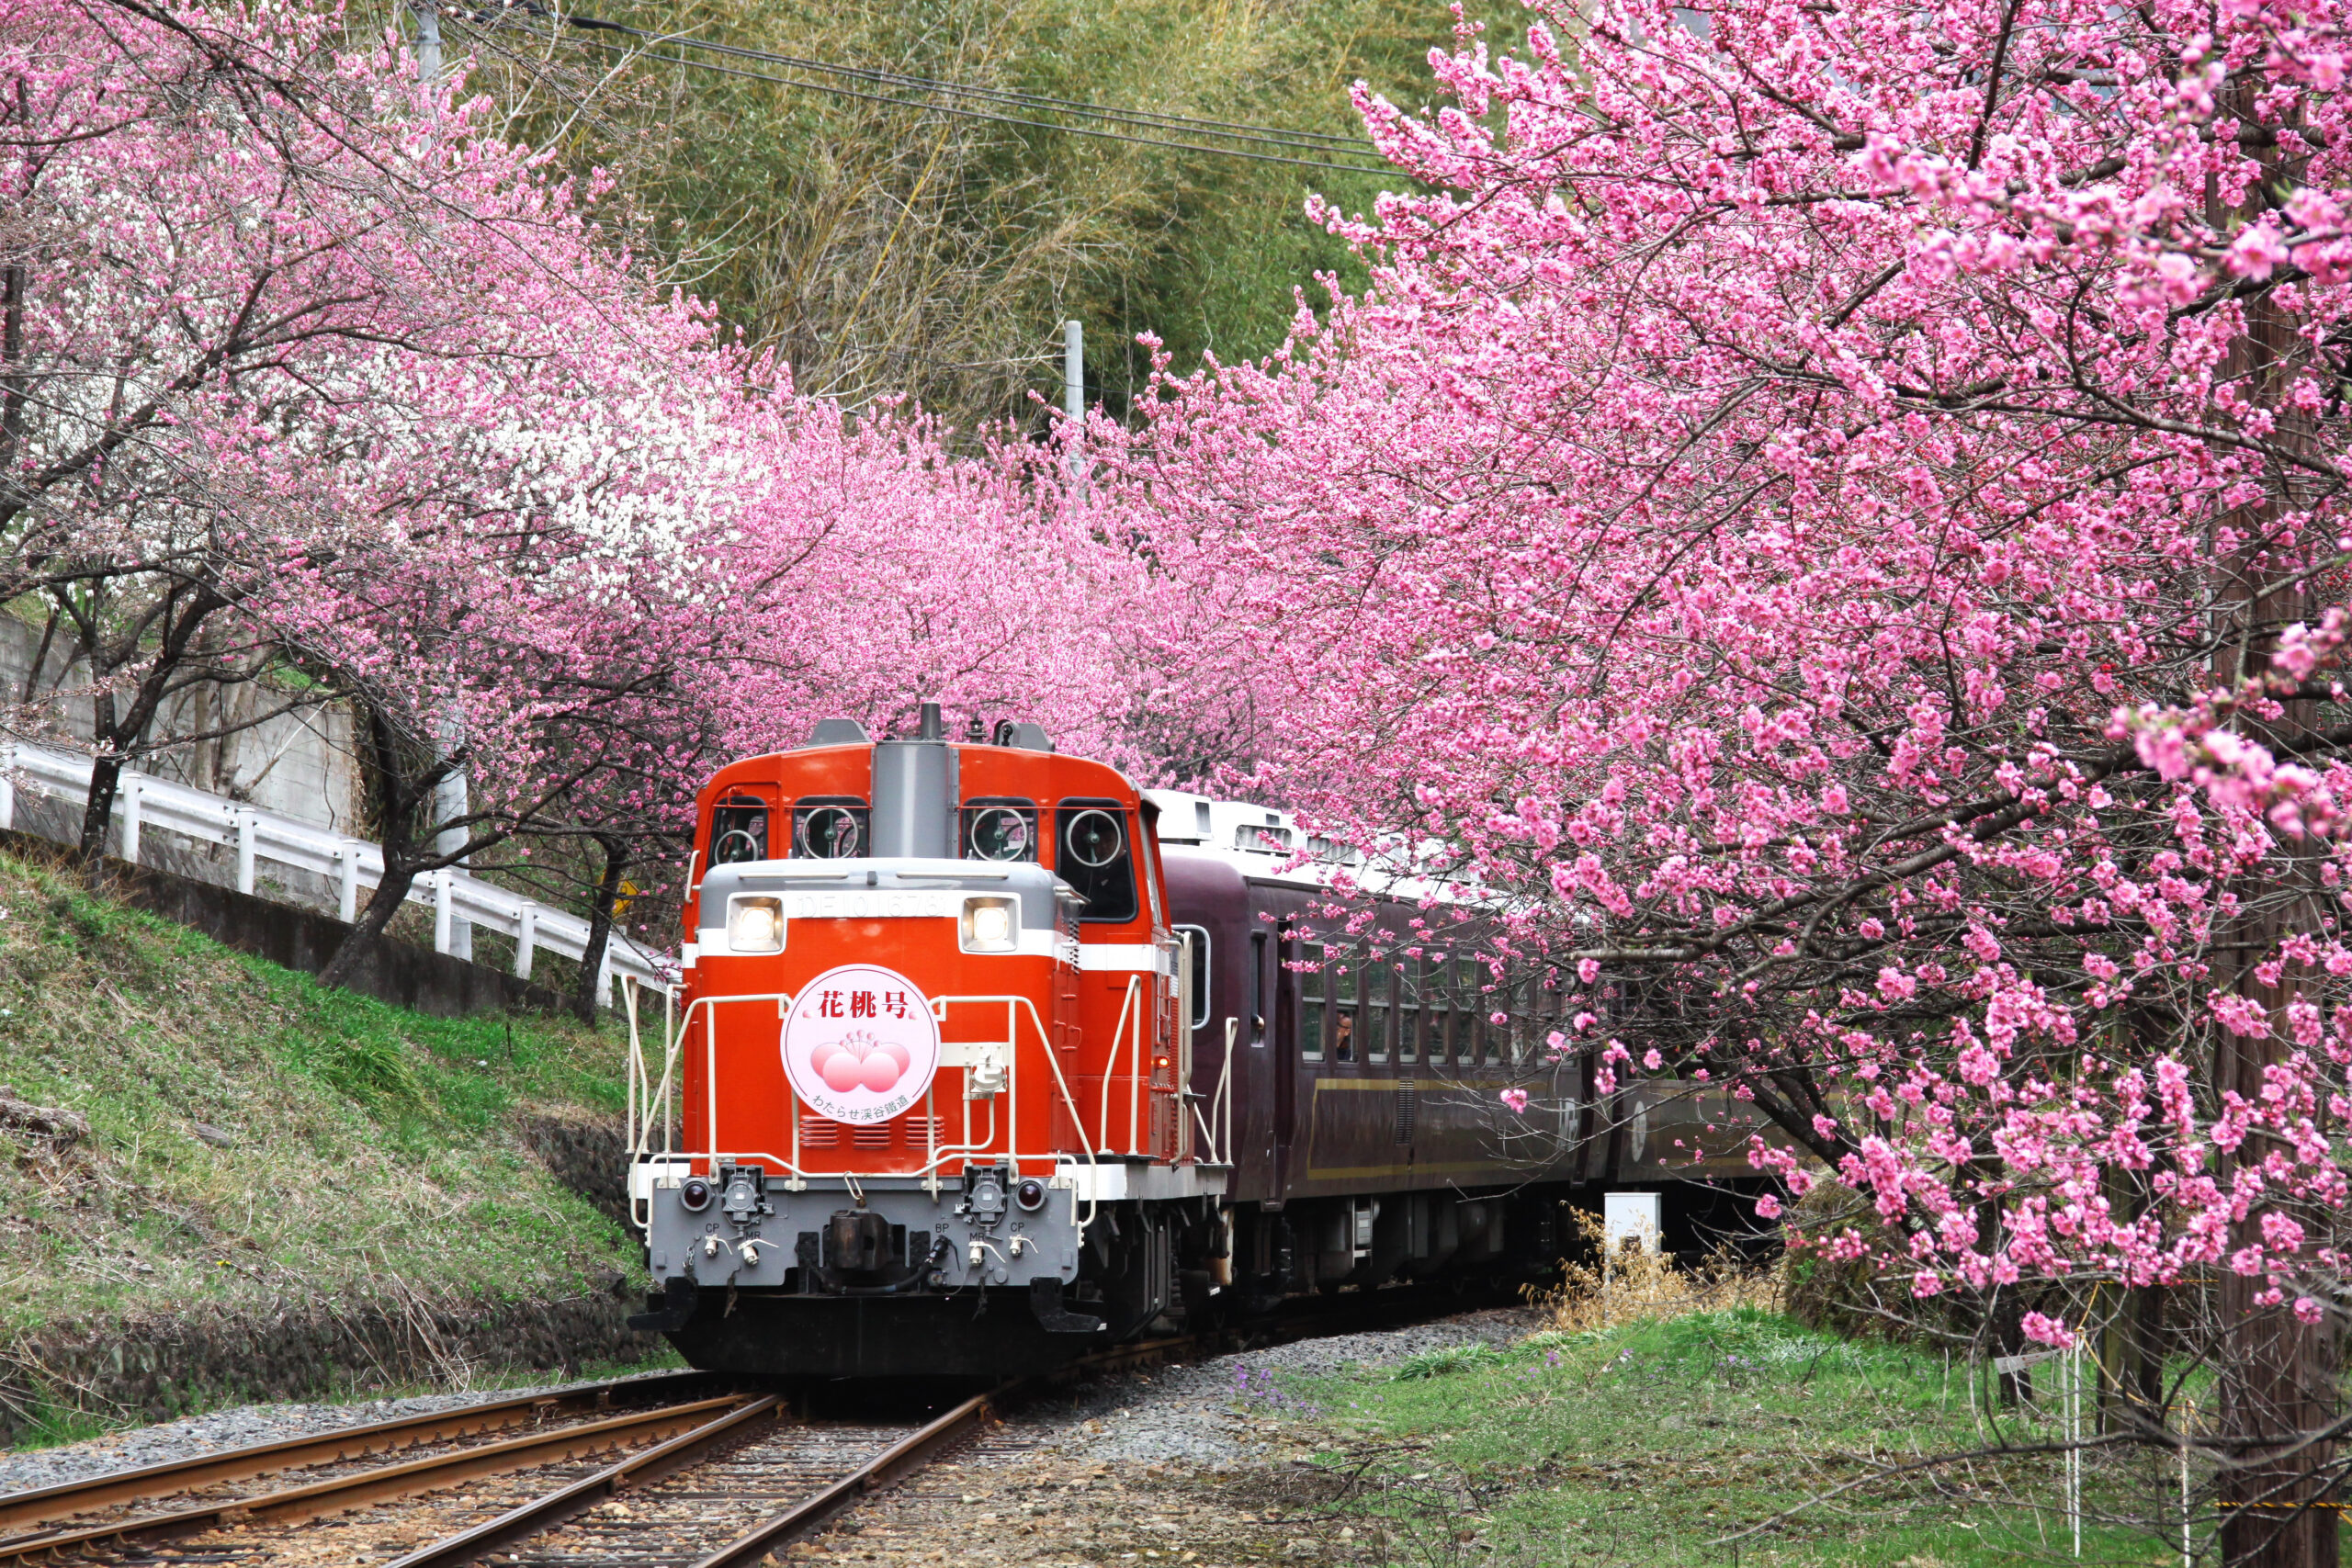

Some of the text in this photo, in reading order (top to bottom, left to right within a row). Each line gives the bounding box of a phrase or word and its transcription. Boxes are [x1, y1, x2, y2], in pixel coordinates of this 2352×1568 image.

[818, 990, 909, 1019] 花桃号
[813, 1095, 909, 1120] わたらせ渓谷鐵道
[705, 1223, 719, 1233] CP
[935, 1223, 949, 1233] BP
[1011, 1222, 1024, 1232] CP
[969, 1232, 985, 1242] MR
